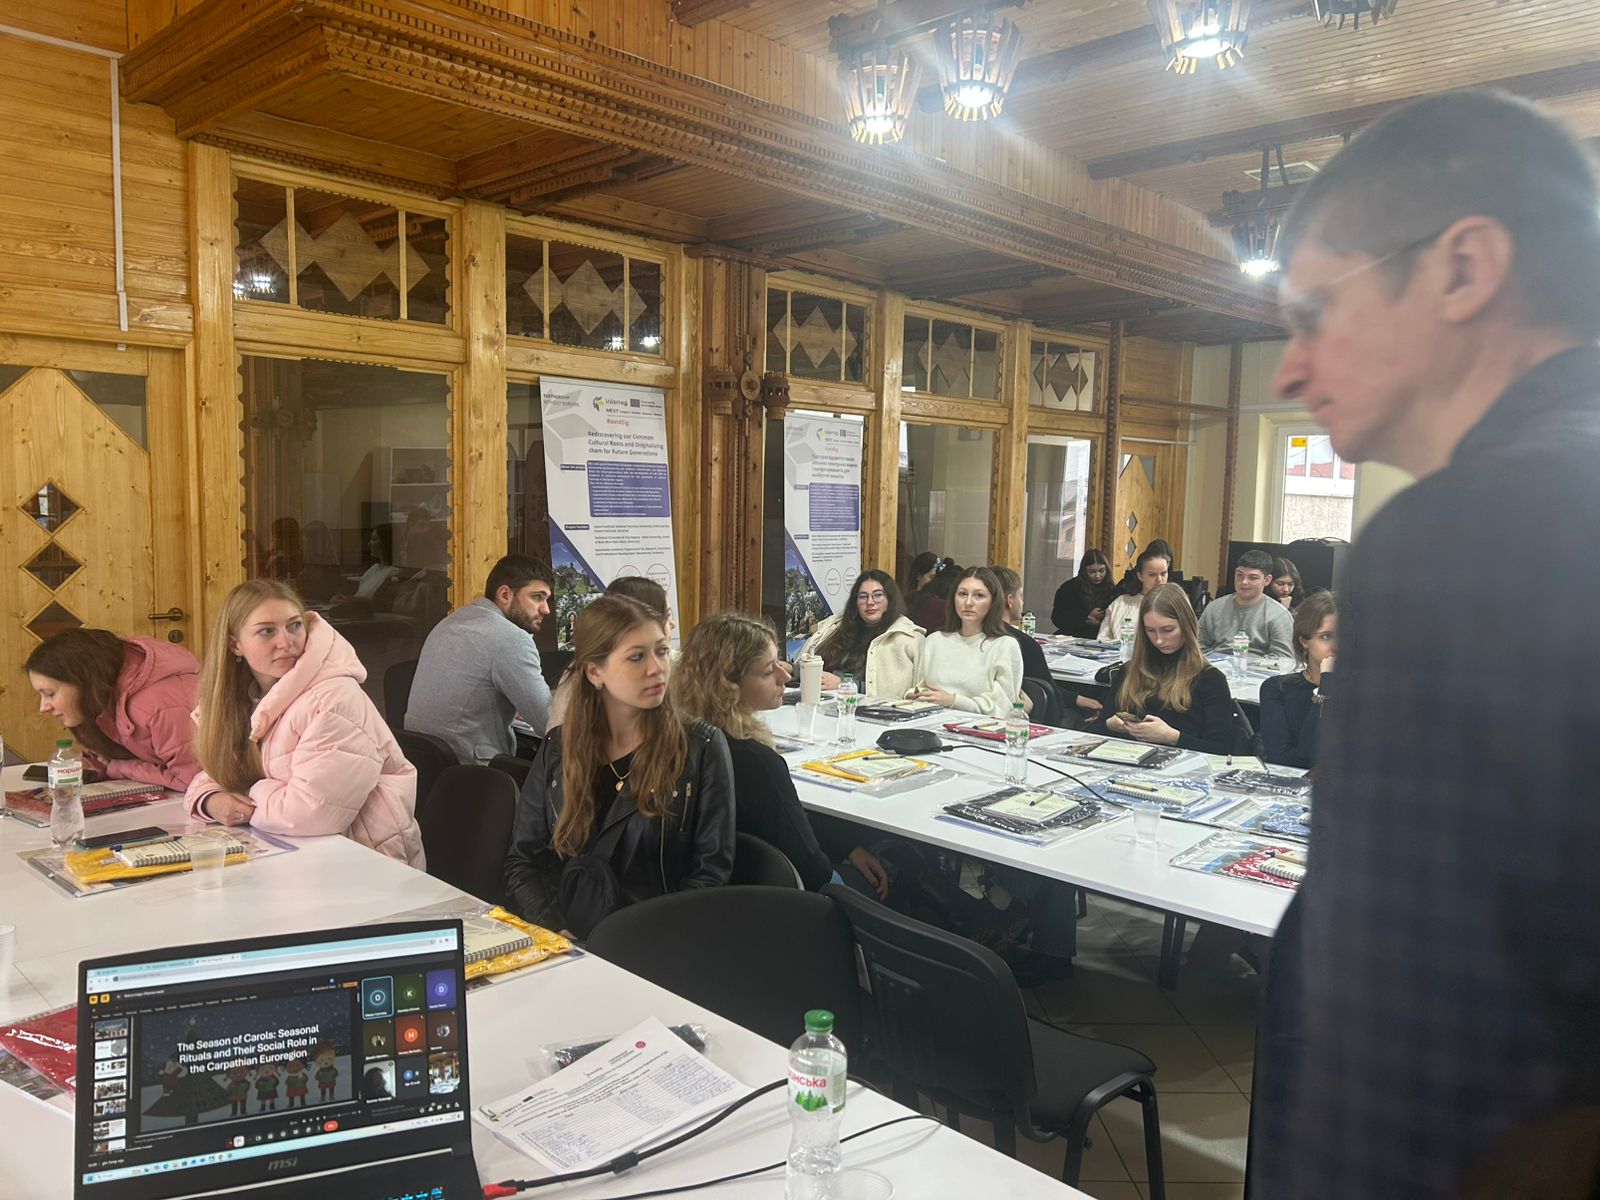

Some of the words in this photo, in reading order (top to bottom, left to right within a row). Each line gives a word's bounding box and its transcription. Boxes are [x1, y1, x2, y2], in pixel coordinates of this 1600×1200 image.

[605, 398, 628, 407] Interreg
[588, 431, 622, 439] Rediscovering
[177, 1042, 195, 1053] The
[196, 1036, 231, 1050] Season
[232, 1034, 242, 1045] of
[243, 1030, 276, 1043] Carols:
[278, 1024, 319, 1038] Seasonal
[179, 1051, 212, 1064] Rituals
[213, 1049, 231, 1059] and
[233, 1044, 256, 1056] Their
[257, 1040, 285, 1053] Social
[287, 1036, 308, 1048] Role
[309, 1036, 318, 1045] in
[189, 1063, 205, 1074] the
[206, 1055, 258, 1071] Carpathian
[259, 1048, 308, 1065] Euroregion
